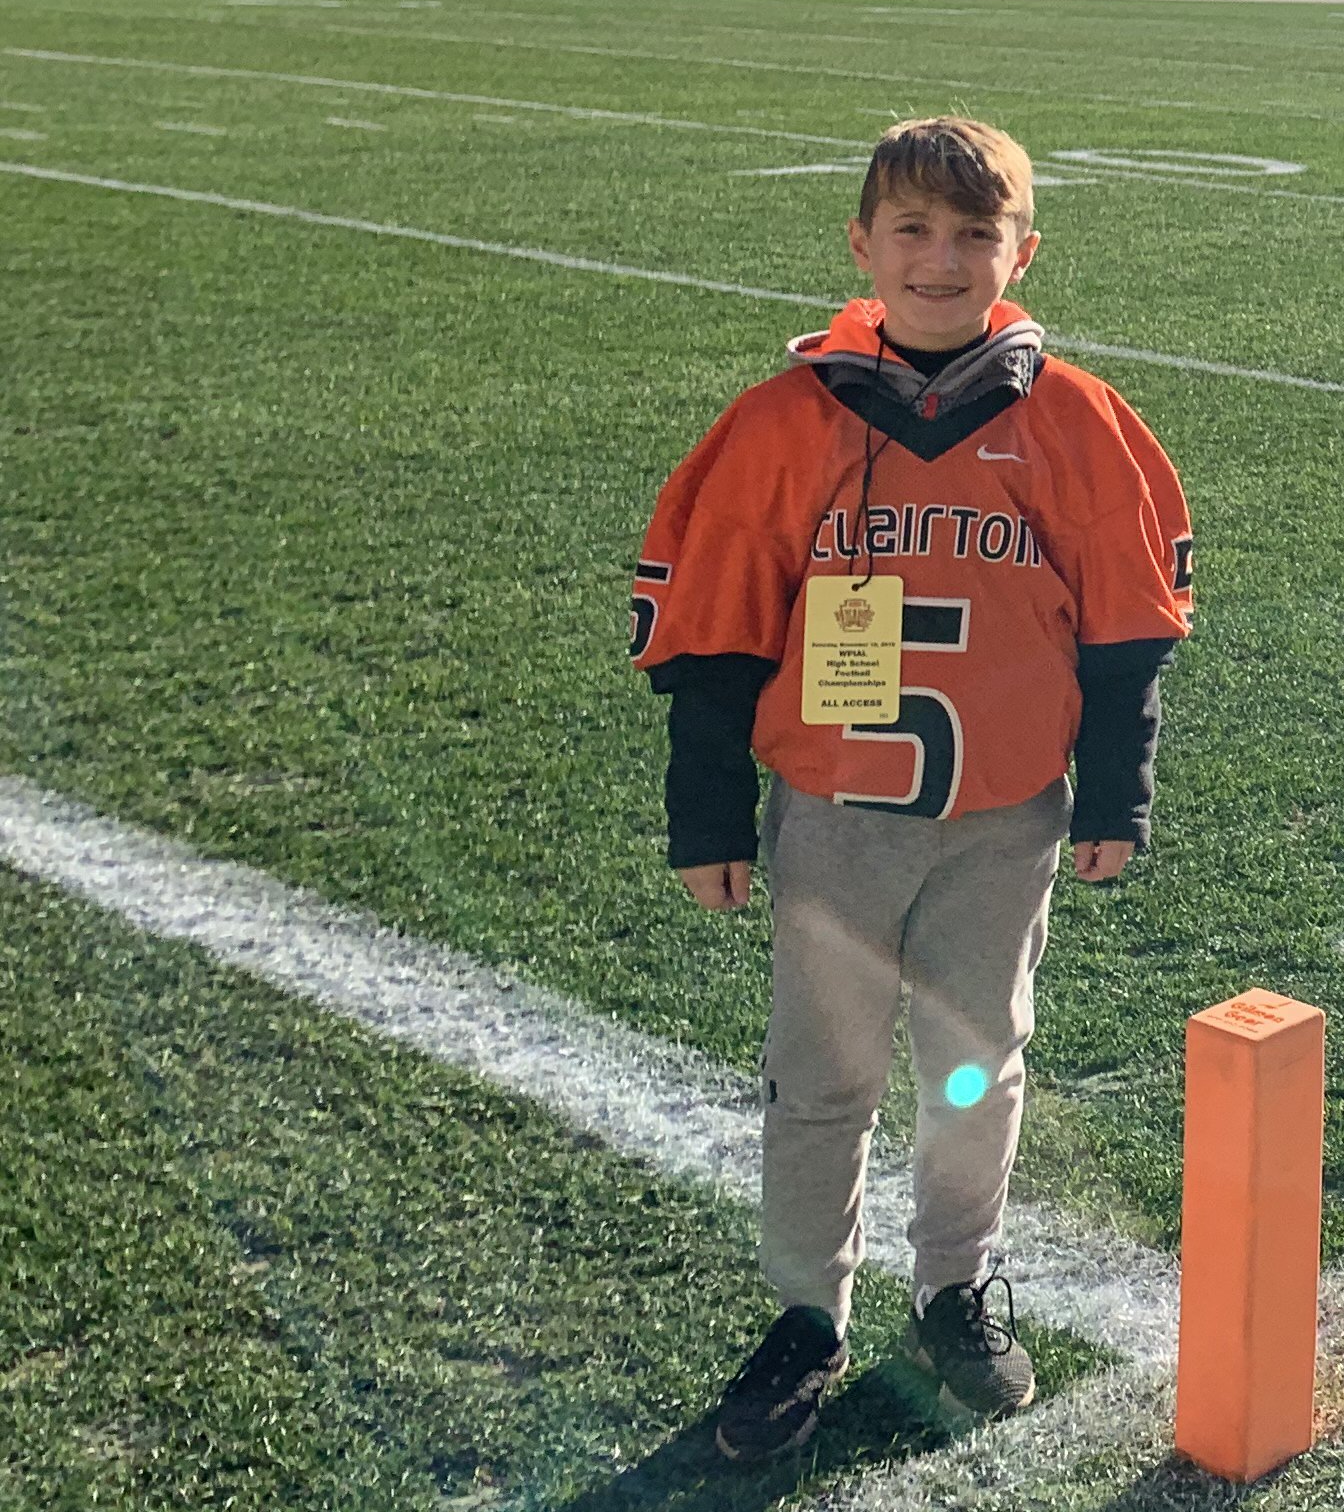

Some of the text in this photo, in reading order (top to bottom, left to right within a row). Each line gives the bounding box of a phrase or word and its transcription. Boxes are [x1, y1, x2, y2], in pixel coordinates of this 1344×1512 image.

[839, 649, 867, 658] WPIAL
[826, 659, 880, 668] High School
[834, 669, 871, 677] Football
[817, 679, 887, 688] Championships
[821, 699, 882, 708] ALL ACCESS
